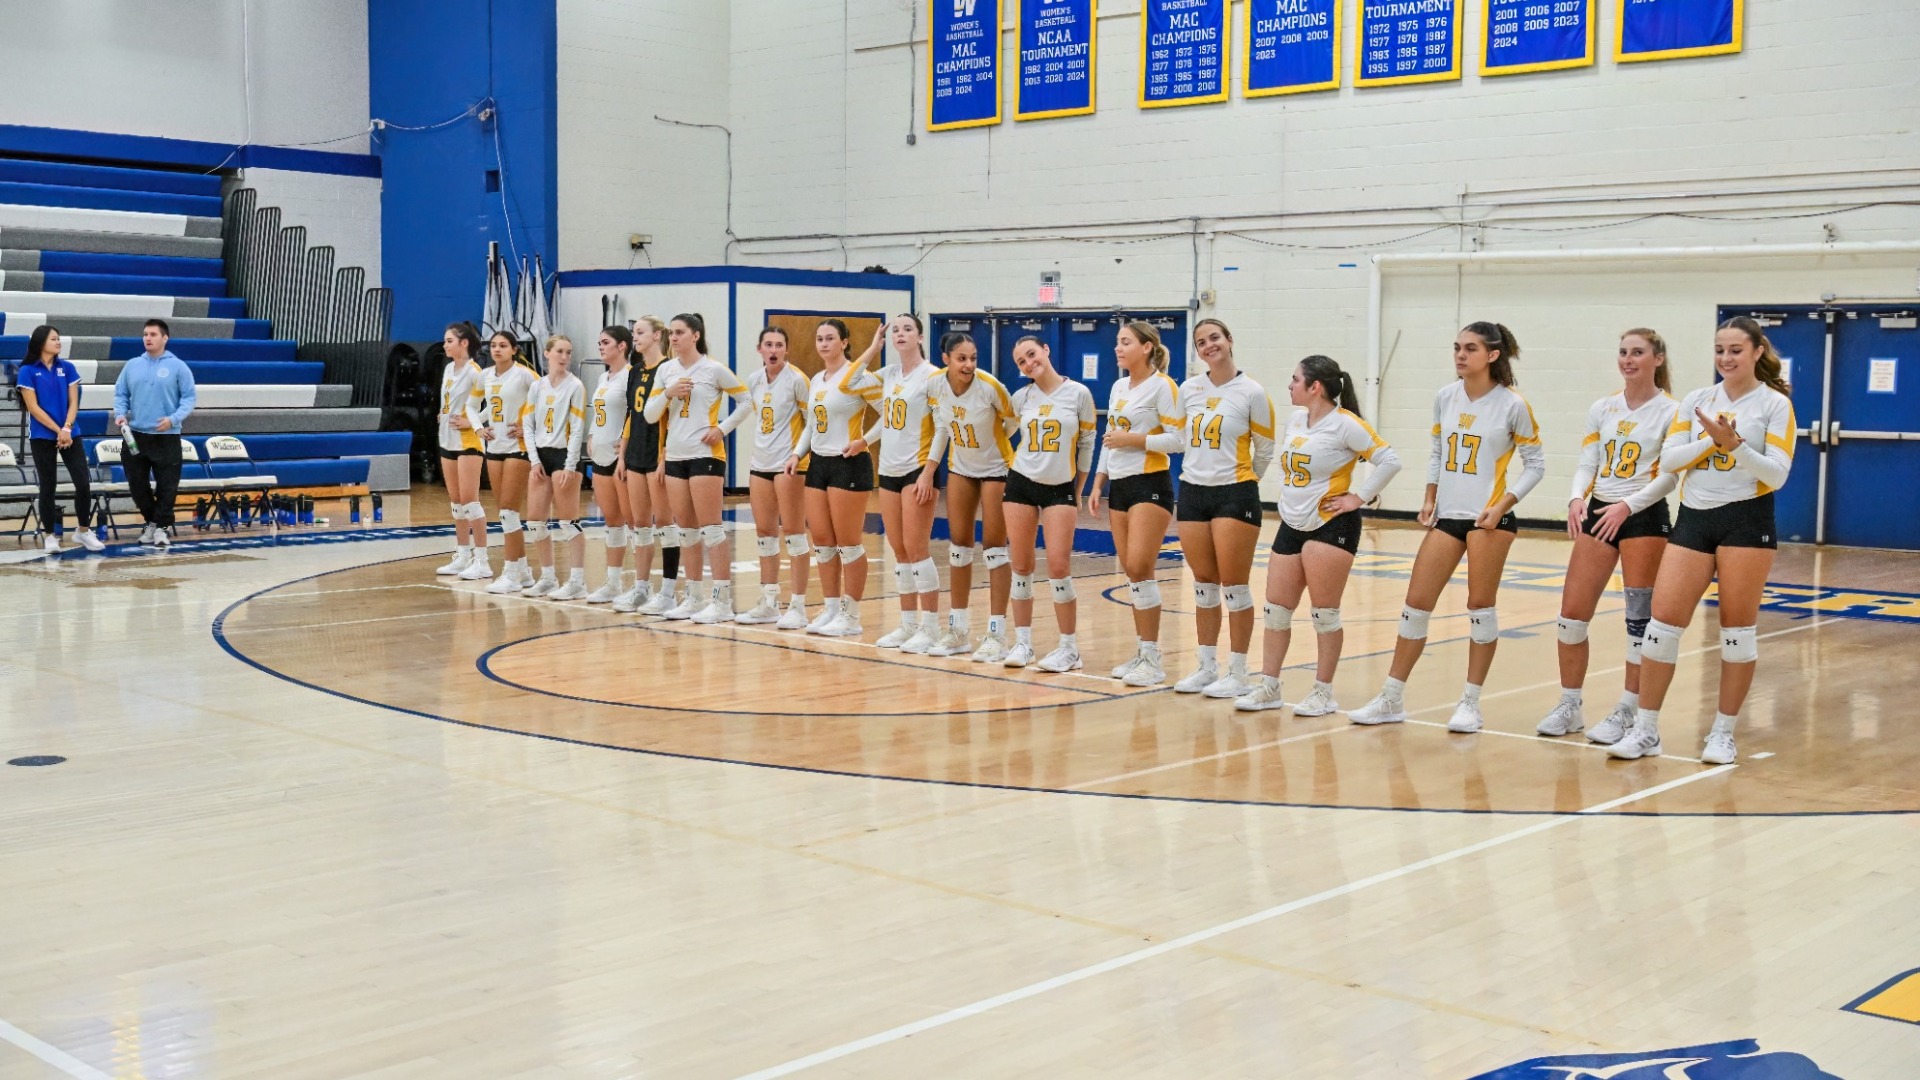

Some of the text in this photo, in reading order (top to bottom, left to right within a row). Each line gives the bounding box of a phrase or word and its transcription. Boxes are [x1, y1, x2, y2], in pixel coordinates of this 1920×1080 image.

[1040, 6, 1072, 17] WOMEN'S
[1162, 0, 1208, 11] BASKETBALL
[1276, 0, 1307, 15] MAC
[1366, 0, 1452, 18] TOURNAMENT
[1496, 1, 1580, 20] 2001 2006 2007
[1035, 15, 1076, 28] BASKETBALL
[1170, 12, 1199, 29] MAC
[1257, 12, 1327, 33] CHAMPIONS
[1370, 17, 1447, 34] 1972 1975 1976
[1494, 15, 1579, 35] 2008 2009 2023
[1038, 29, 1072, 45] NCAA
[1152, 28, 1216, 46] CHAMPIONS
[1256, 30, 1328, 47] 2007 2008 2009
[1369, 30, 1446, 47] 1977 1978 1982
[1494, 36, 1517, 48] 2024
[952, 42, 976, 58] MAC
[1022, 43, 1088, 62] TOURNAMENT
[1176, 47, 1192, 57] 1972
[1199, 44, 1216, 54] 1976
[1256, 50, 1276, 60] 2023
[1369, 44, 1445, 60] 1983 1985 1987
[937, 56, 991, 74] CHAMPIONS
[1152, 61, 1168, 71] 1977
[1198, 69, 1216, 79] 1987
[1368, 57, 1446, 73] 1995 1997 2000
[1067, 71, 1085, 81] 2024
[1151, 86, 1168, 95] 1997
[634, 386, 646, 412] 6
[490, 396, 504, 422] 2
[594, 399, 606, 427] 5
[884, 397, 908, 430] 10
[544, 408, 554, 434] 4
[762, 406, 774, 434] 8
[814, 404, 828, 434] 9
[950, 420, 980, 448] 11
[1028, 418, 1061, 452] 12
[1191, 414, 1224, 449] 14
[1446, 432, 1482, 476] 17
[1600, 440, 1642, 480] 18
[1281, 451, 1311, 488] 15
